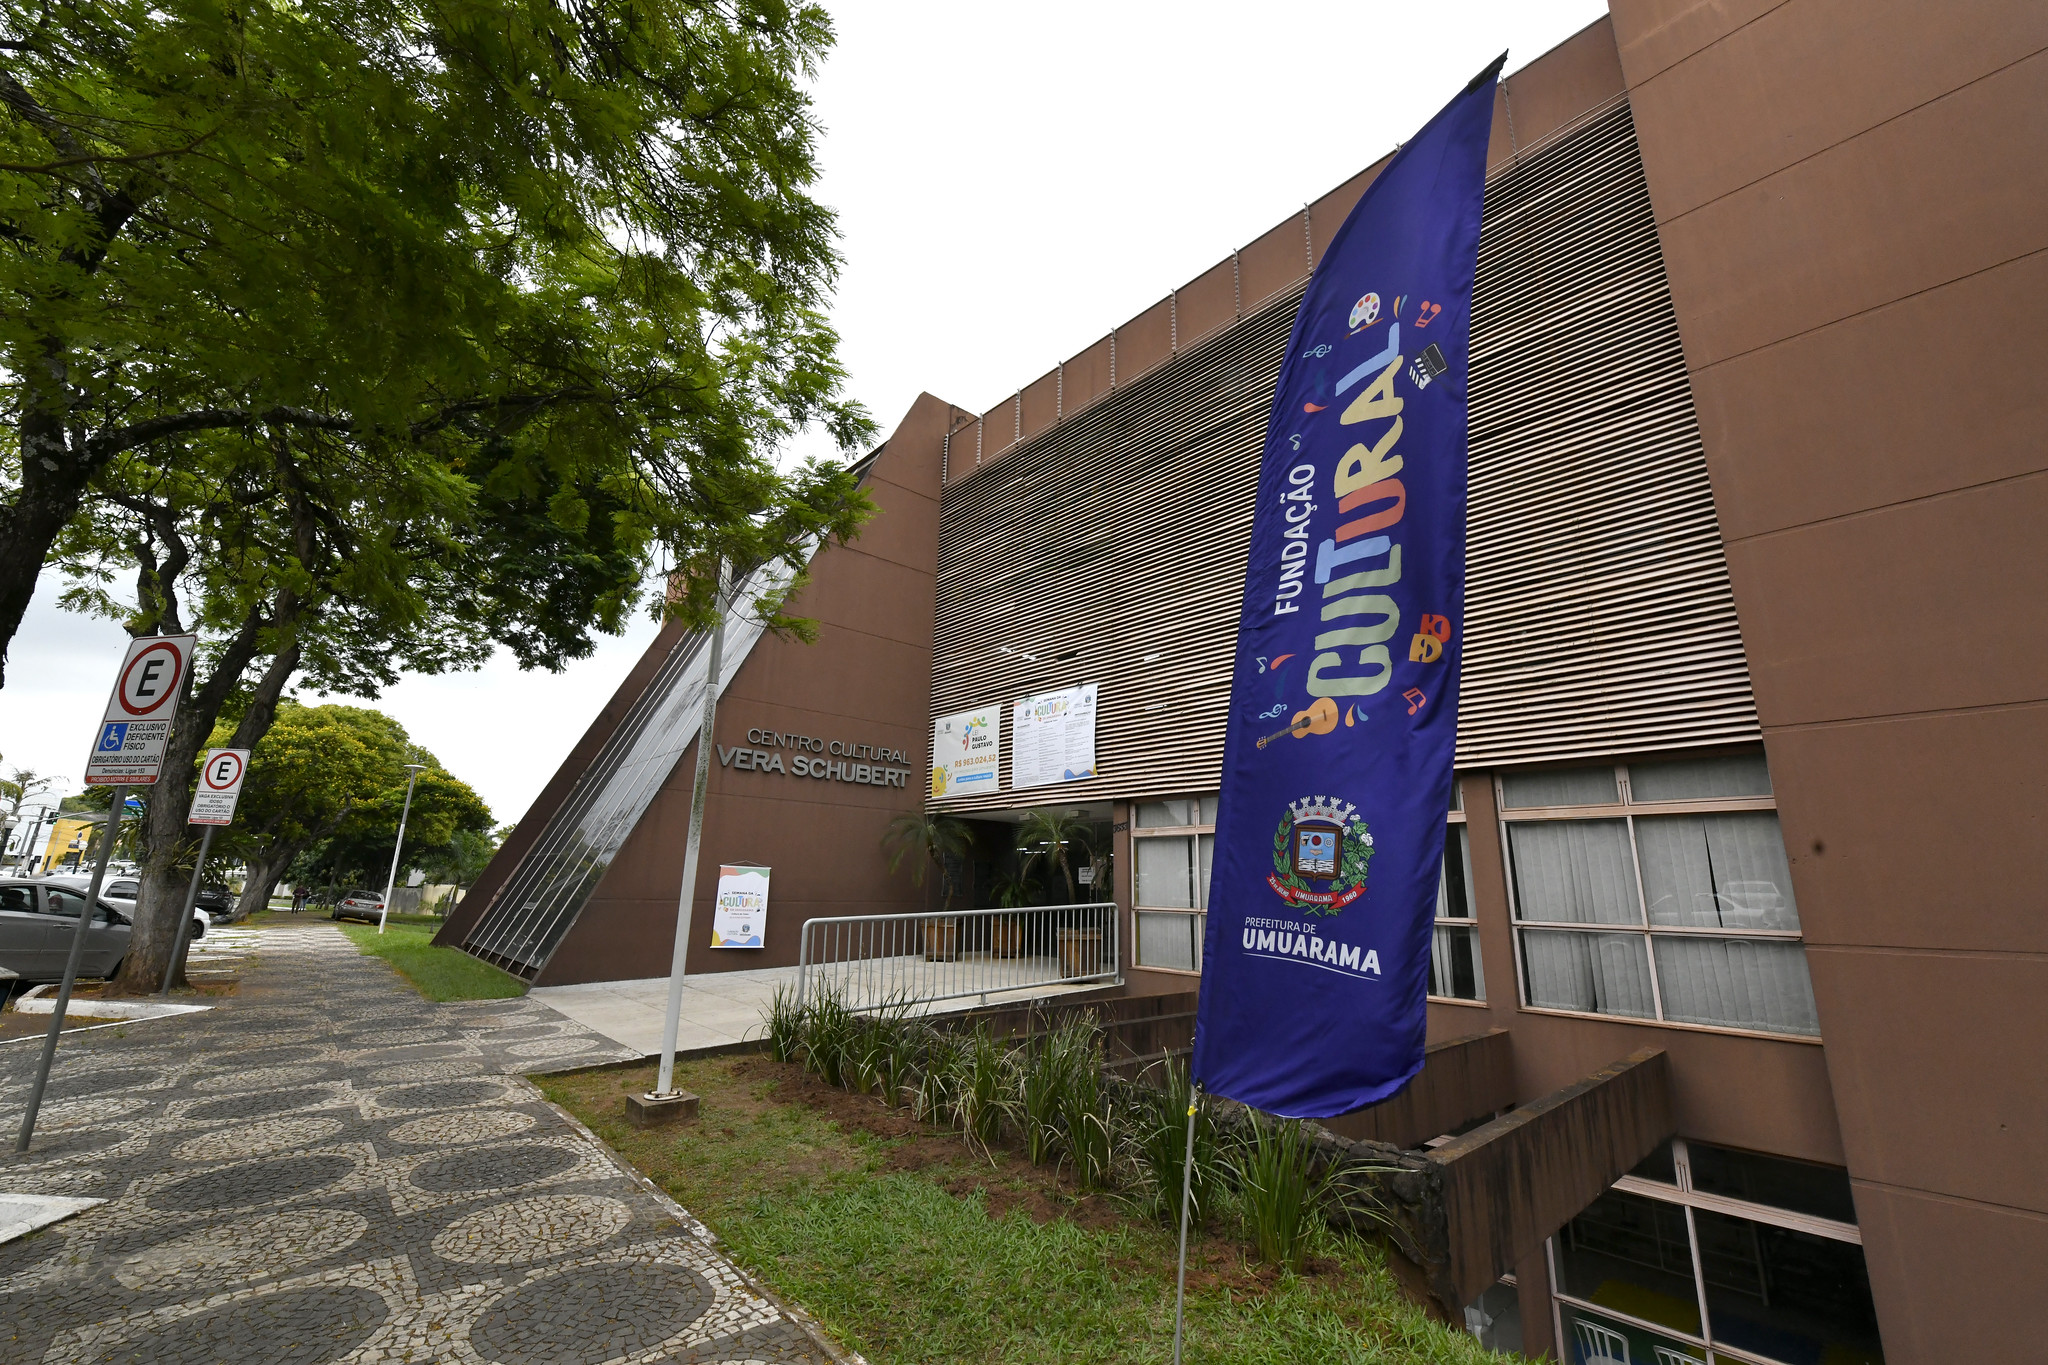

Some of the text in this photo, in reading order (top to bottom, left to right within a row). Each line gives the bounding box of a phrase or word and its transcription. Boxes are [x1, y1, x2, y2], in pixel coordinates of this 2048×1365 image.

[1306, 322, 1406, 698] CULTURAL
[1274, 463, 1317, 616] FUNDAÇÃO
[136, 659, 165, 697] E
[1037, 701, 1067, 717] CULTURA
[129, 723, 167, 731] EXCLUSIVO
[126, 732, 165, 741] DEFICIENTE
[971, 735, 987, 743] PAULO
[123, 741, 146, 751] FÍSICO
[747, 728, 912, 765] CENTRO CULTURAL
[971, 741, 993, 750] GUSTAVO
[91, 754, 160, 764] OBRIGATÓRIO USO DO CARTÃO
[716, 743, 911, 788] VERA SCHUBERT
[954, 759, 962, 768] R$
[216, 761, 232, 781] E
[723, 895, 760, 908] CULTURA
[1294, 890, 1333, 902] UMUARAMA
[1341, 890, 1358, 904] 1960
[1244, 916, 1317, 935] PREFEITURA DE
[1242, 927, 1382, 975] UMUARAMA
